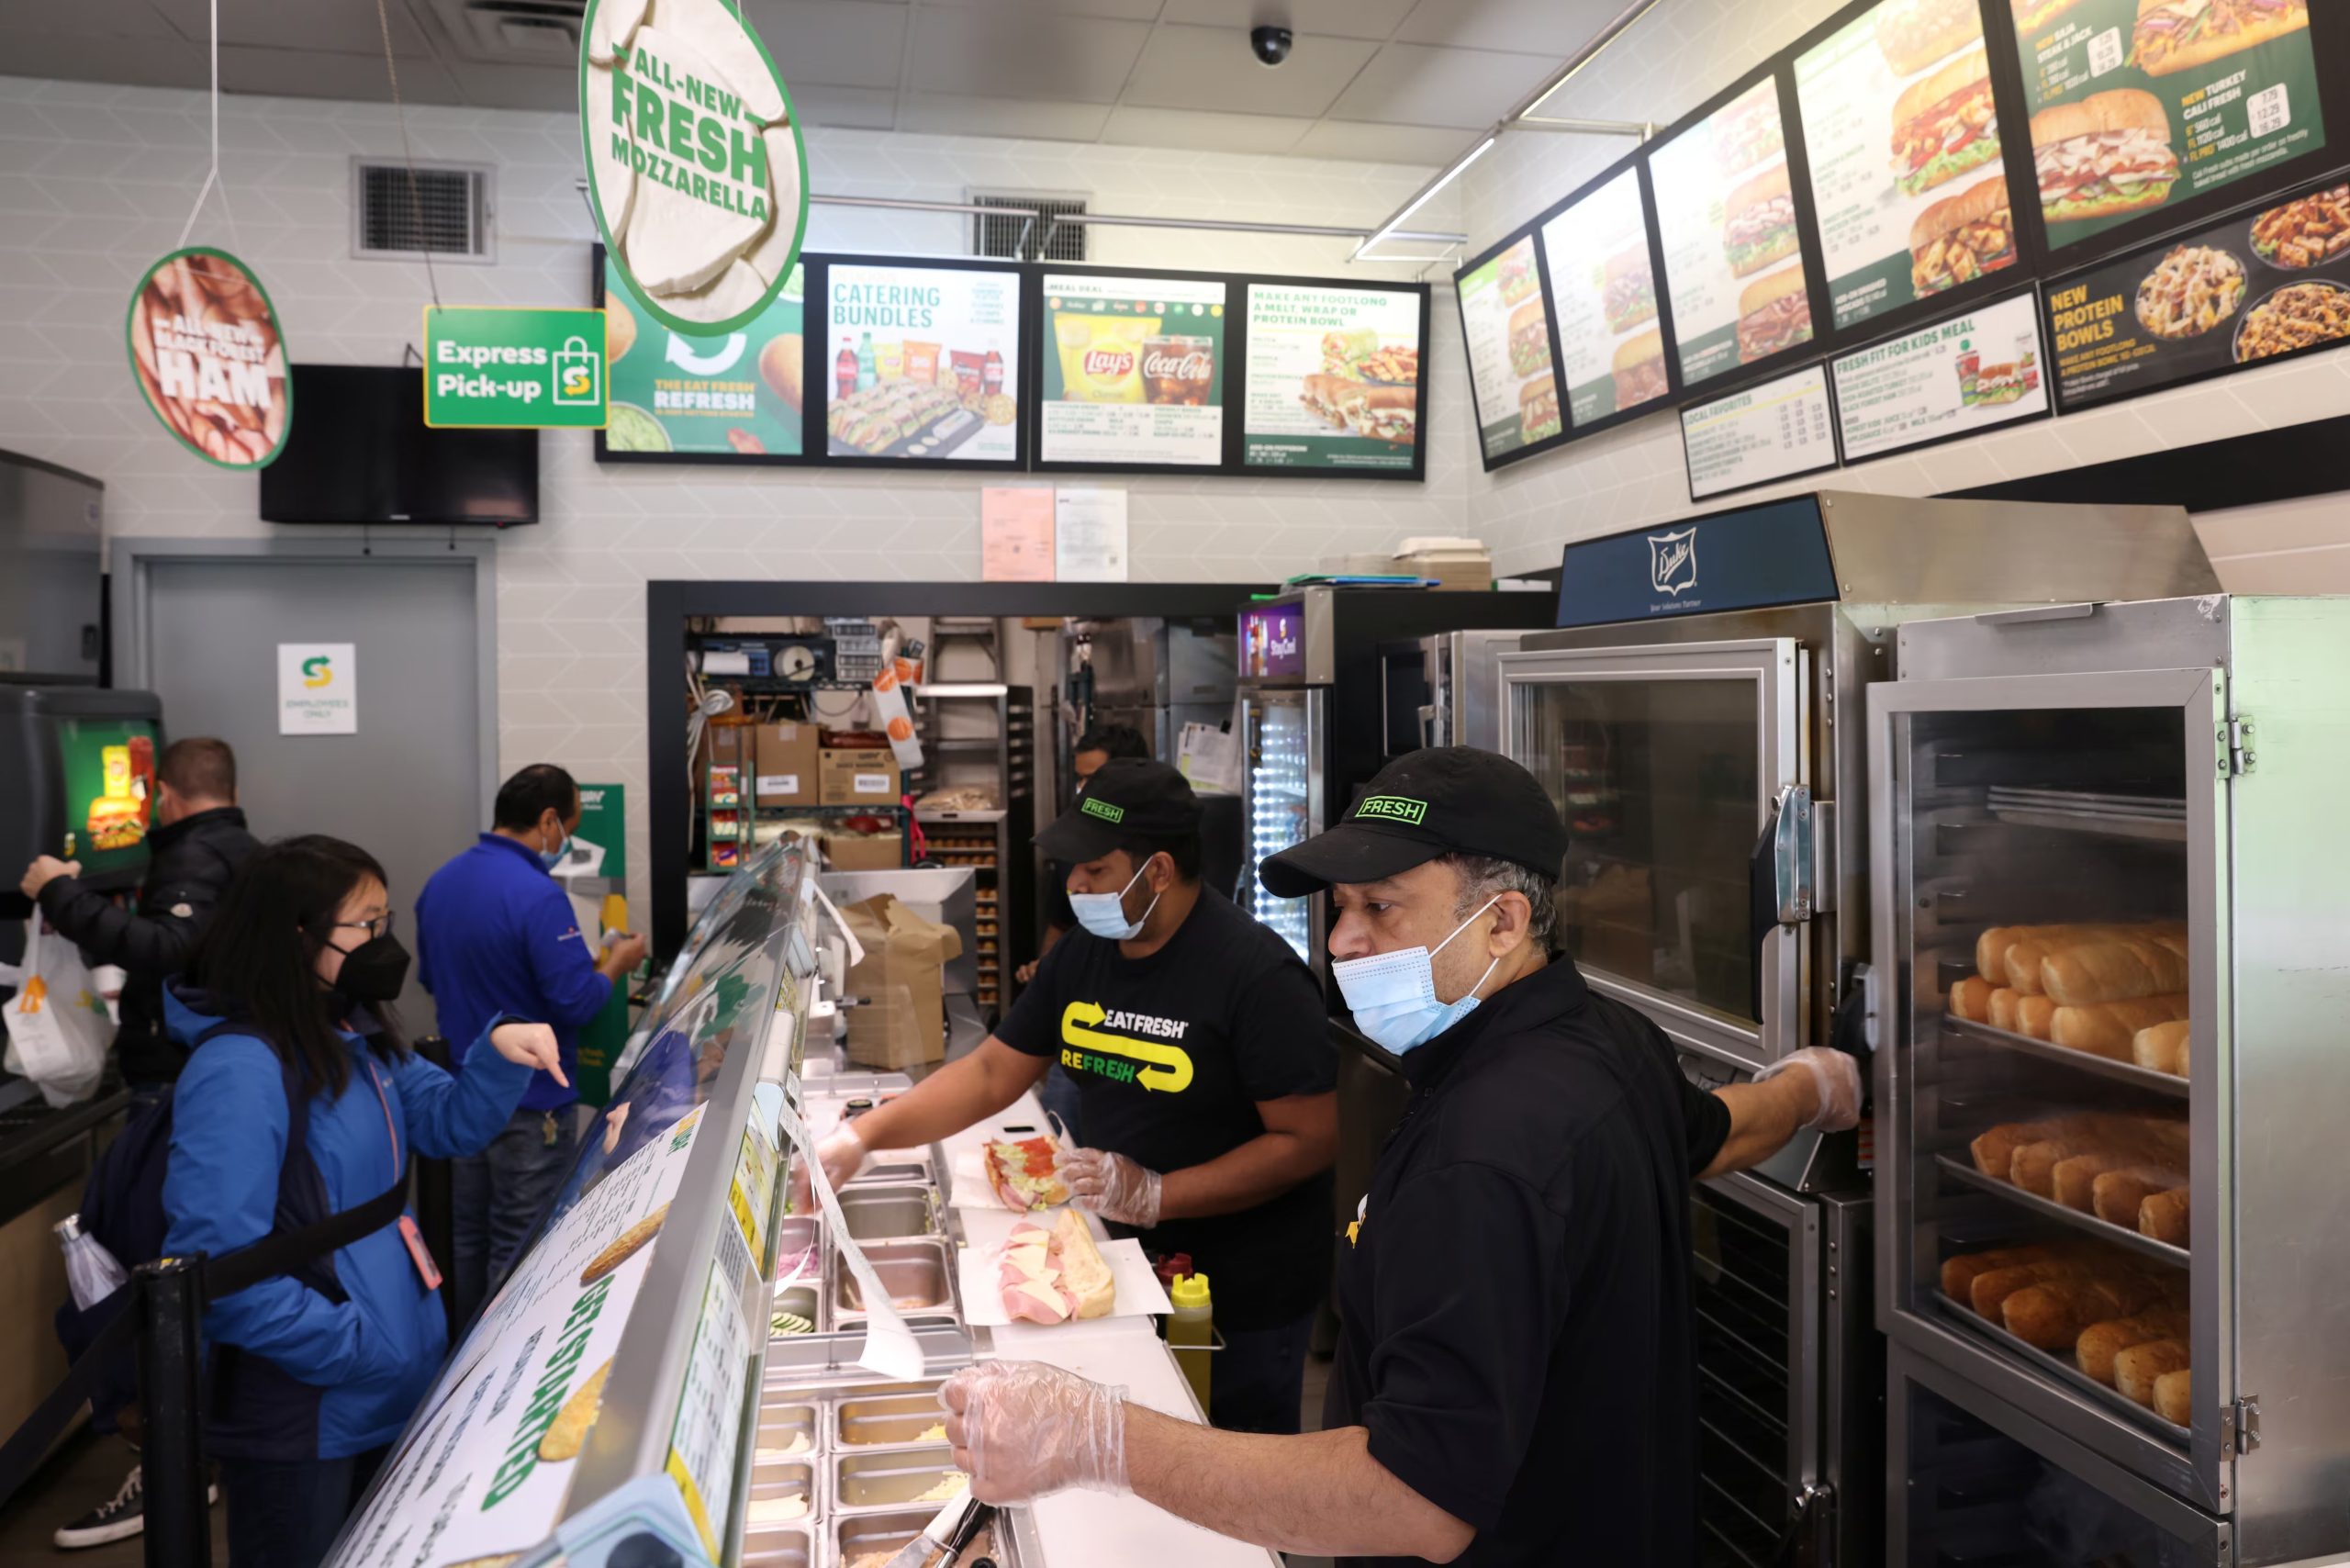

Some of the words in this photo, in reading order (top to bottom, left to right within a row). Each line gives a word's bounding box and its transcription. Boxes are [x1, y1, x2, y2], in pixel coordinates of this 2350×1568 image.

[634, 47, 742, 121] ALL-NEW
[2181, 88, 2206, 107] NEW
[2206, 69, 2246, 96] TURKEY
[2183, 101, 2208, 120] CALI
[2208, 85, 2242, 109] FRESH
[612, 66, 767, 190] FRESH
[612, 132, 767, 223] MOZZARELLA
[834, 283, 941, 307] CATERING
[1254, 292, 1290, 301] MAKE
[1293, 294, 1318, 303] ANY
[1322, 296, 1387, 307] FOOTLONG
[1302, 306, 1338, 315] WRAP
[2050, 284, 2087, 312] NEW
[834, 306, 933, 328] BUNDLES
[1253, 315, 1307, 325] PROTEIN
[1310, 317, 1345, 327] BOWL
[2053, 294, 2124, 332] PROTEIN
[1837, 353, 1869, 375] FRESH
[1871, 348, 1886, 364] FIT
[1888, 340, 1909, 359] FOR
[1911, 330, 1939, 351] KIDS
[1942, 319, 1975, 341] MEAL
[2056, 319, 2114, 353] BOWLS
[437, 340, 548, 369] Express
[1087, 350, 1133, 376] Lay's
[158, 349, 272, 408] HAM
[437, 374, 542, 404] Pick-up
[655, 390, 755, 411] REFRESH
[1086, 801, 1120, 820] FRESH
[1361, 800, 1420, 819] FRESH
[1061, 1049, 1135, 1083] REFRESH
[557, 1273, 616, 1344] GET
[480, 1327, 594, 1512] STARTED
